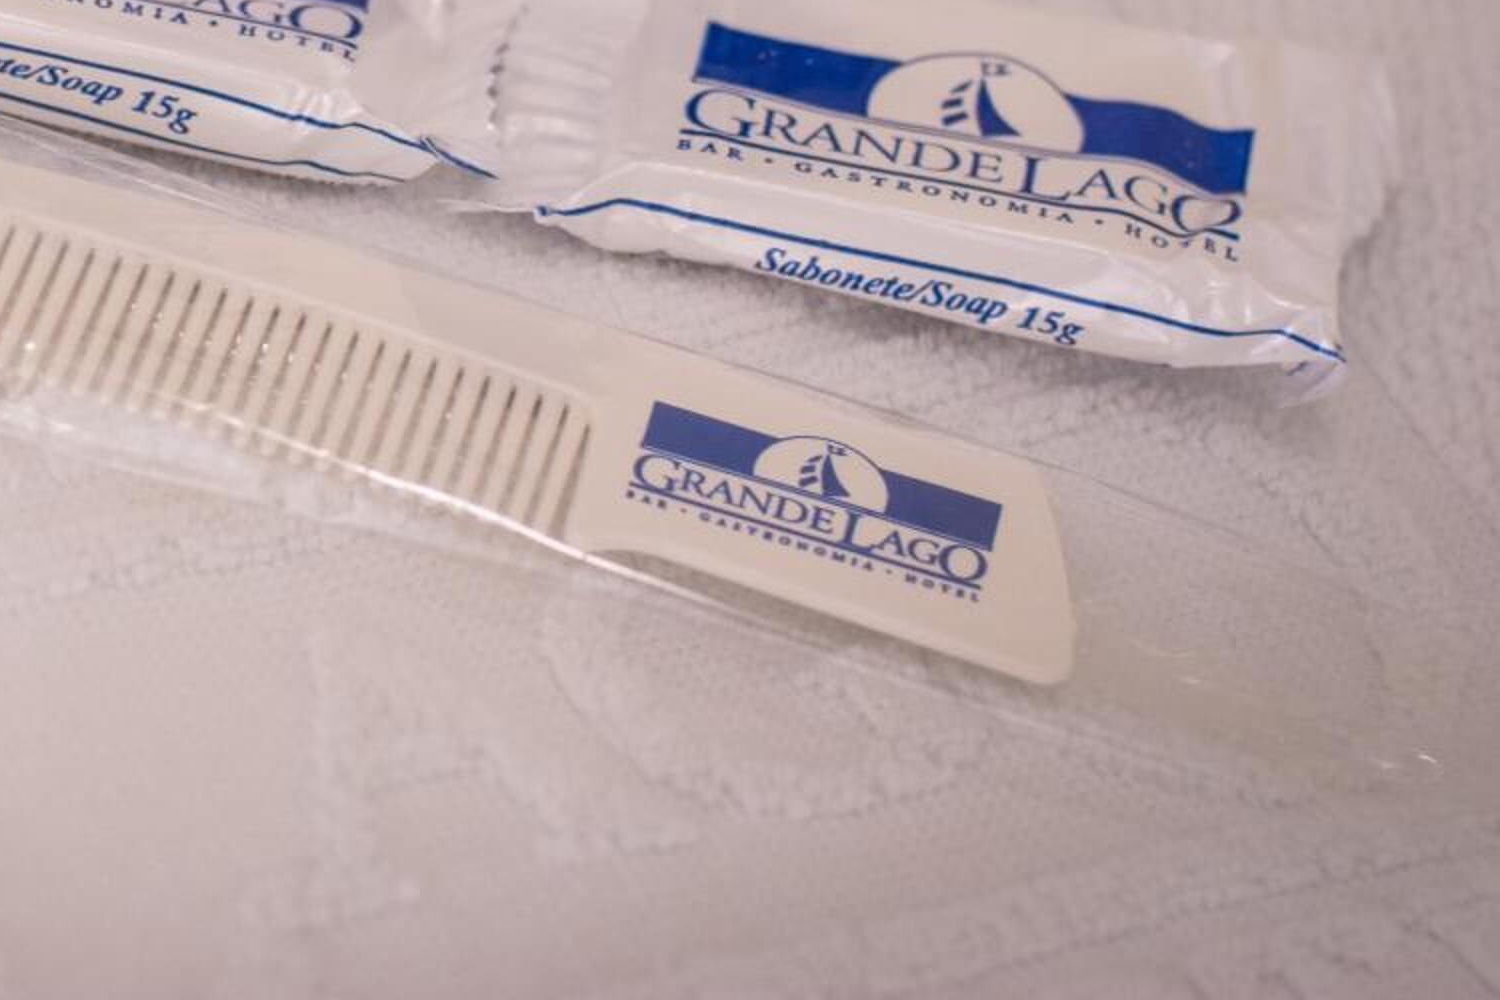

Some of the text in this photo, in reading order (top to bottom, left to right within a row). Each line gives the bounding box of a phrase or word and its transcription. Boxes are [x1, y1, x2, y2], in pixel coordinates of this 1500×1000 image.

[237, 23, 357, 64] HOTEL
[130, 90, 199, 136] 15g
[676, 138, 1241, 263] BAR GASTRONOMIA HOTEL
[755, 246, 1087, 347] Sabonete/Soap 15g
[904, 572, 982, 604] HOTEL
